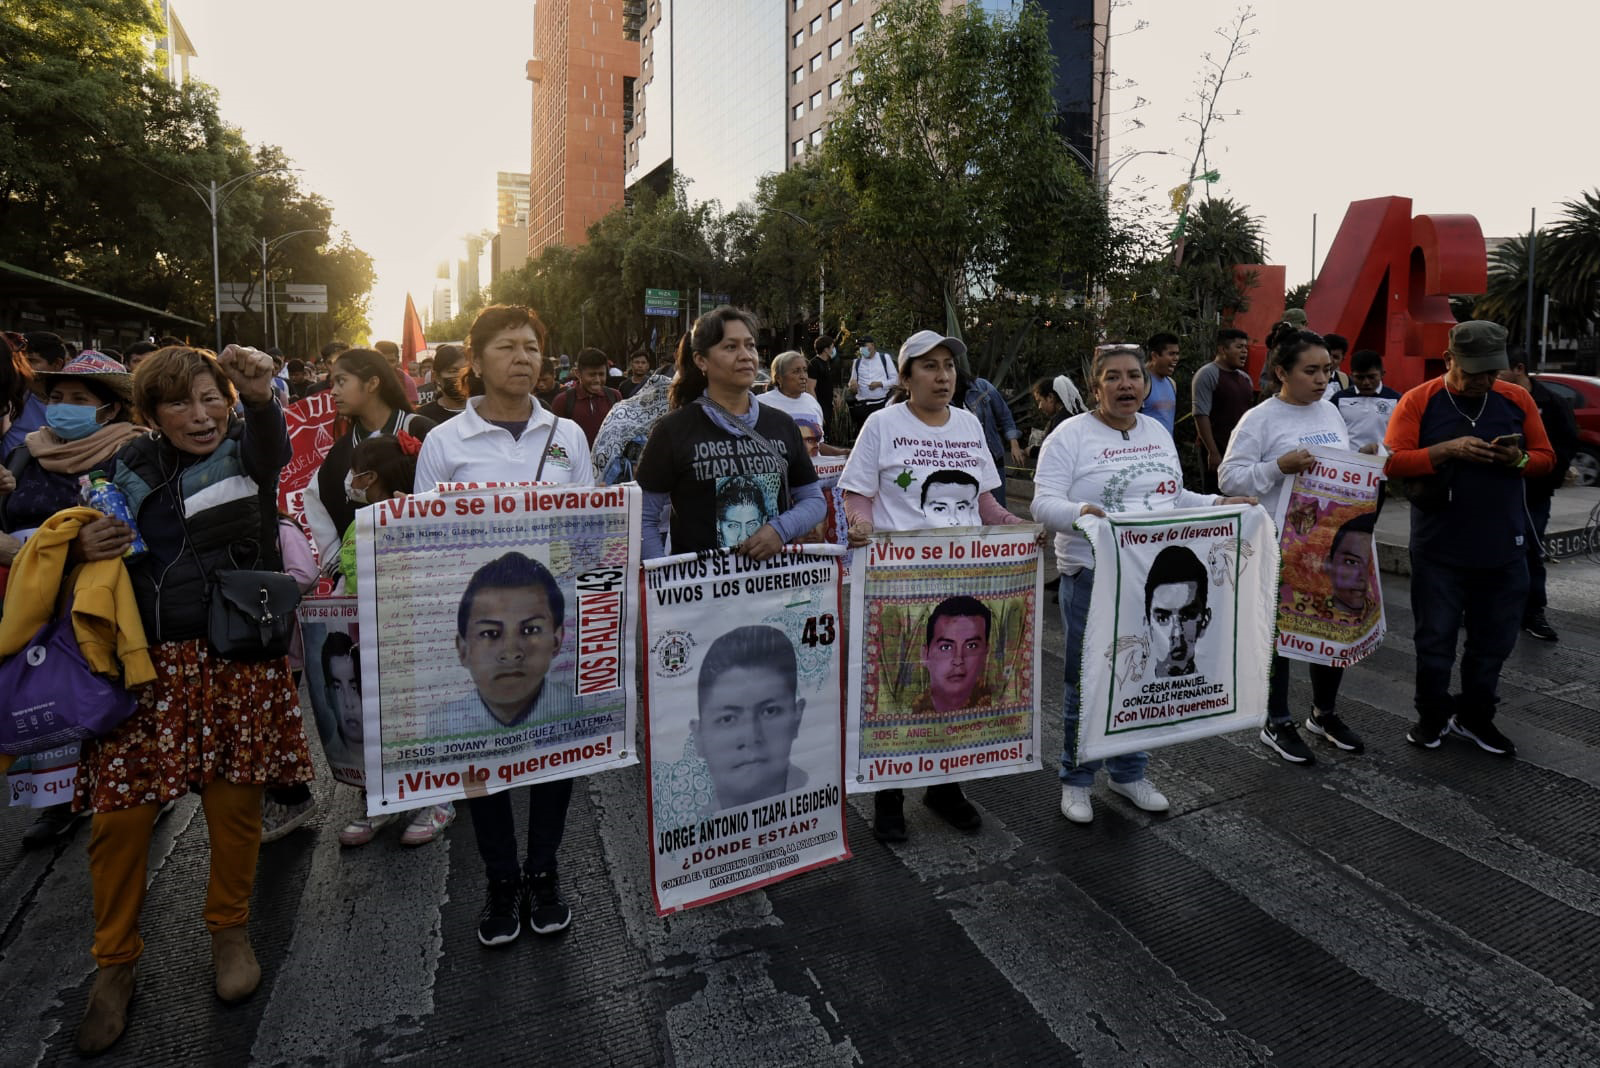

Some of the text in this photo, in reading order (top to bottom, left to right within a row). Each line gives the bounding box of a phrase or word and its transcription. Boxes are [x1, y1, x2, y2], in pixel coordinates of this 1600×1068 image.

[693, 440, 735, 461] JORGE
[913, 449, 939, 458] JOSÉ
[922, 439, 933, 447] se
[933, 439, 944, 449] lo
[945, 439, 982, 449] llevaron!
[1093, 444, 1161, 459] Ayotzinapa
[692, 456, 739, 481] TIZAPA
[903, 458, 946, 468] CAMPOS
[1155, 480, 1177, 495] 43
[1342, 470, 1361, 485] se
[379, 495, 447, 526] ¡Vivo
[455, 497, 486, 516] se
[494, 495, 517, 514] lo
[524, 487, 625, 511] llevaron!
[452, 527, 488, 536] Glasgow,
[492, 525, 527, 534] Escocia,
[1150, 532, 1164, 544] se
[1166, 529, 1179, 542] lo
[1180, 522, 1234, 540] llevaron!
[869, 540, 1037, 566] ¡Vivo se lo llevaron
[1549, 538, 1564, 556] SE
[712, 553, 731, 577] SE
[736, 551, 761, 573] LOS
[656, 567, 832, 606] VIVOS LOS QUEREMOS!!!
[319, 607, 328, 617] se
[330, 607, 339, 617] lo
[580, 591, 620, 655] FALTAN
[802, 613, 836, 648] 43
[1319, 641, 1335, 656] lo
[580, 656, 618, 694] NOS
[1141, 675, 1208, 694] CÉSAR MANUEL
[1122, 683, 1224, 708] GONZÁLEZ HERNÁNDEZ
[1113, 694, 1229, 728] ¡Con VIDA lo queremos!
[397, 745, 435, 760] JESÚS
[443, 739, 488, 755] JOVANY
[495, 725, 555, 747] RODRÍGUEZ
[562, 714, 613, 732] TLATEMPA
[872, 729, 899, 741] JOSÉ
[906, 727, 939, 738] ÁNGEL
[944, 721, 983, 736] CAMPOS
[397, 736, 613, 800] ¡Vivo lo queremos!
[869, 742, 1024, 781] ¡Vivo lo queremos!
[658, 783, 840, 855] JORGE ANTONIO TIZAPA LEGIDEÑO
[682, 817, 819, 870] ¿DÓNDE ESTÁN?
[661, 830, 838, 891] CONTRA EL TERRORISMO DE ESTADO, LA SOLIDARIDAD
[709, 854, 800, 889] AYOTZINAPA SOMOS TODOS
